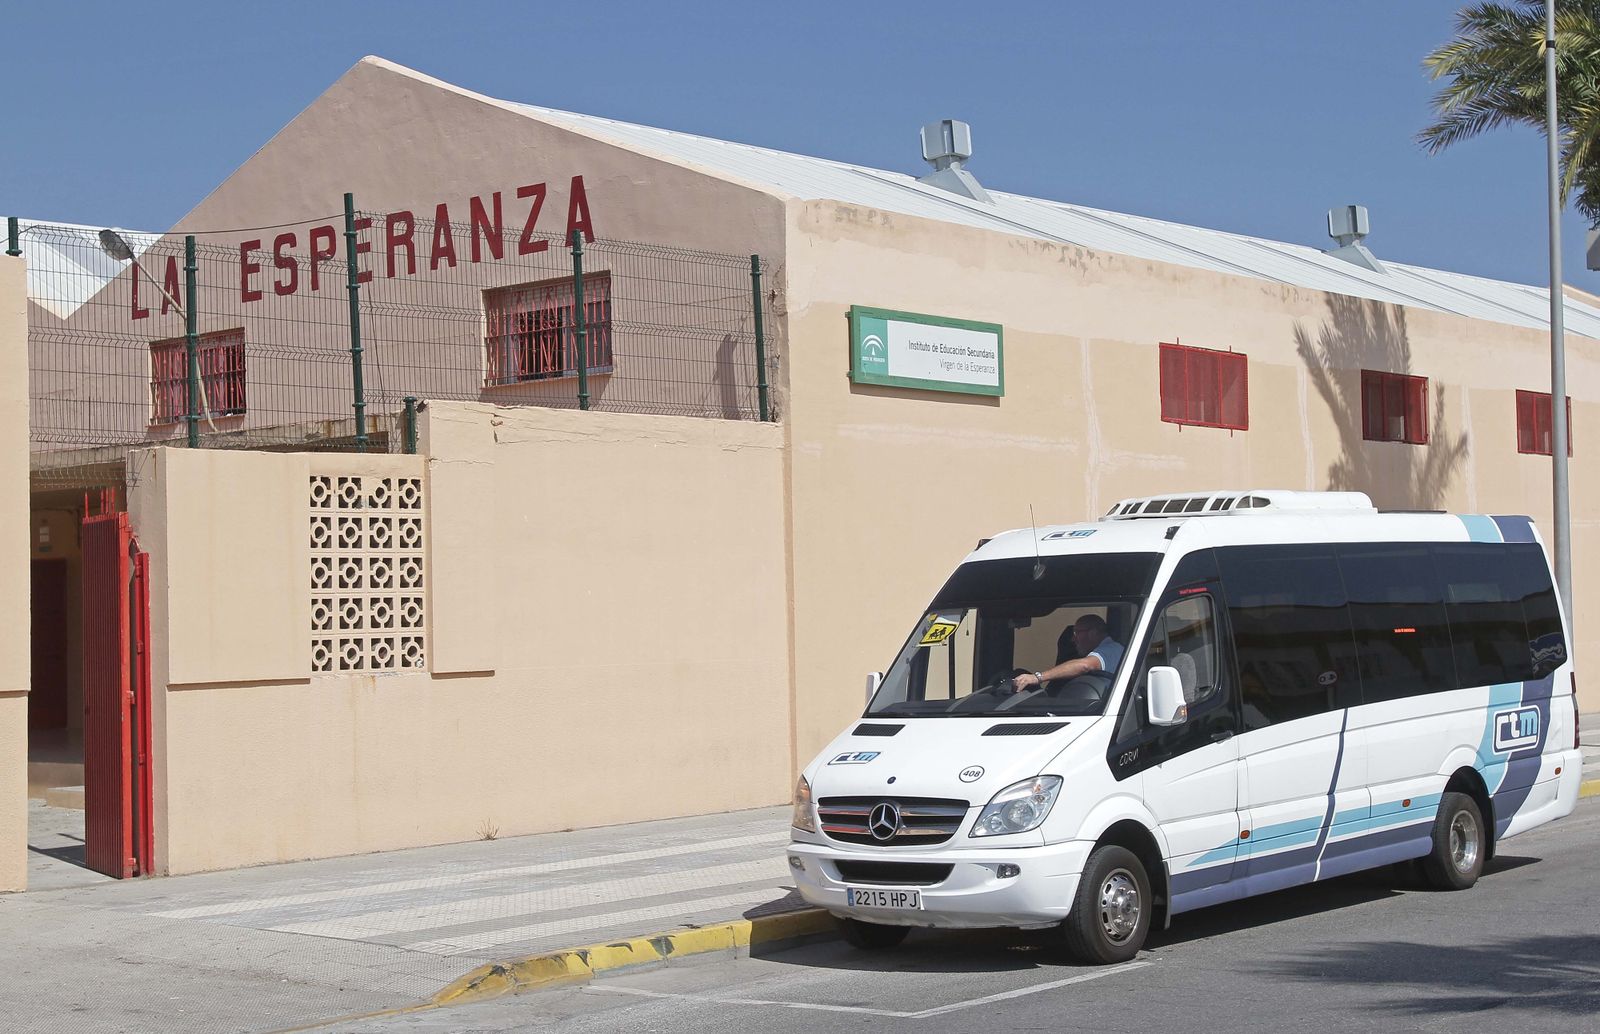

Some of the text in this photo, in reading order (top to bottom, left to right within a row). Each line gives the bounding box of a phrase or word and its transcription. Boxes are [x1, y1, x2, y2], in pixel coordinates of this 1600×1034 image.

[132, 175, 595, 320] LA ESPERANZA
[908, 340, 995, 359] Instituto de Educación Secundaria
[939, 359, 995, 375] Virgen de la Esperanza
[963, 770, 981, 778] 408
[855, 890, 887, 906] 2215
[890, 892, 917, 908] HPJ
